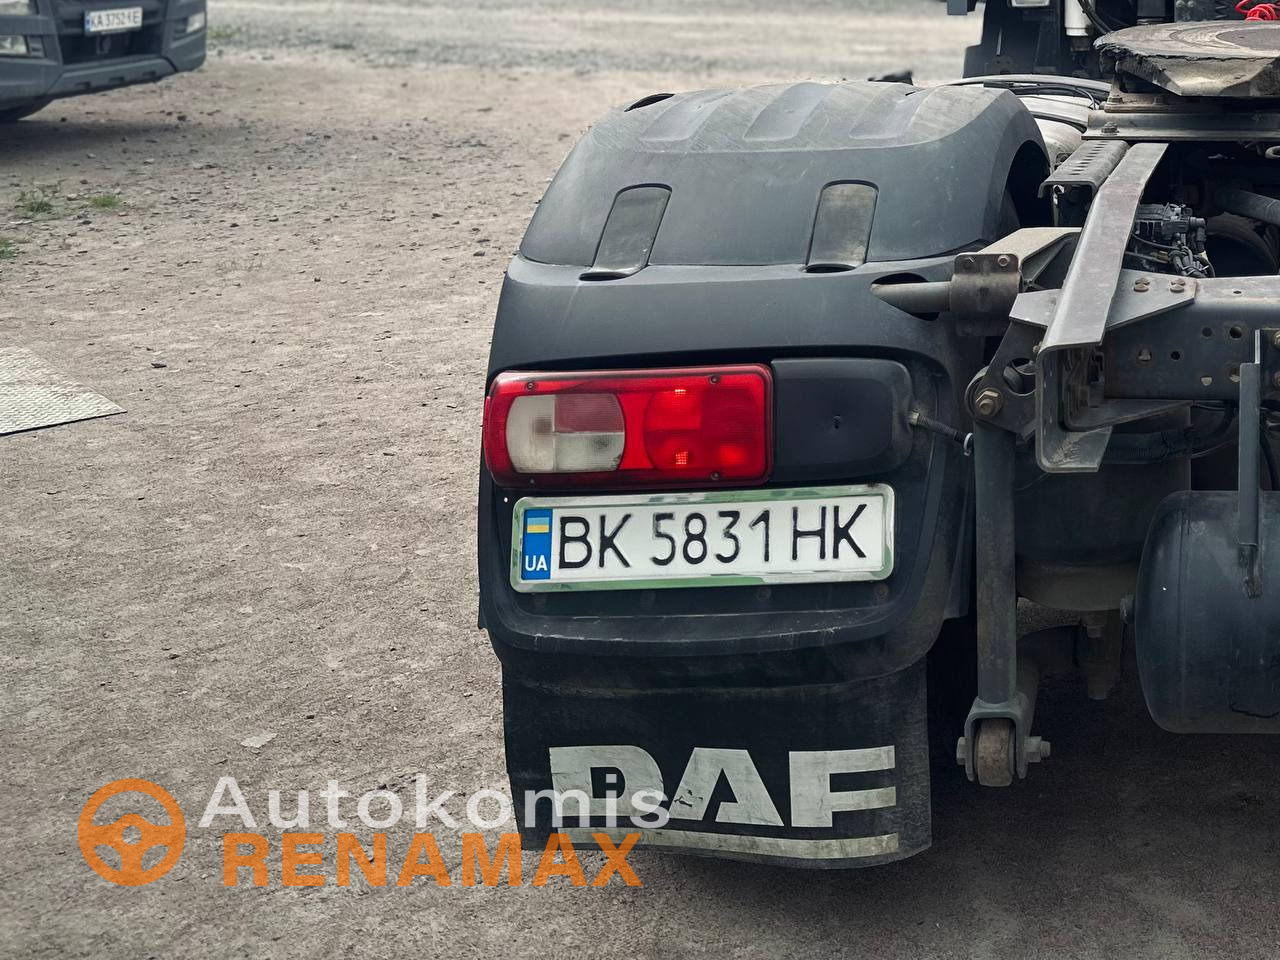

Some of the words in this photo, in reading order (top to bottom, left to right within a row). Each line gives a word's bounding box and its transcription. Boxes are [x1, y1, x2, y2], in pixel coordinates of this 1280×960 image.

[525, 555, 548, 571] UA
[558, 513, 633, 570] BK
[650, 508, 771, 567] 5831
[791, 503, 868, 561] HK
[548, 744, 898, 828] DAF
